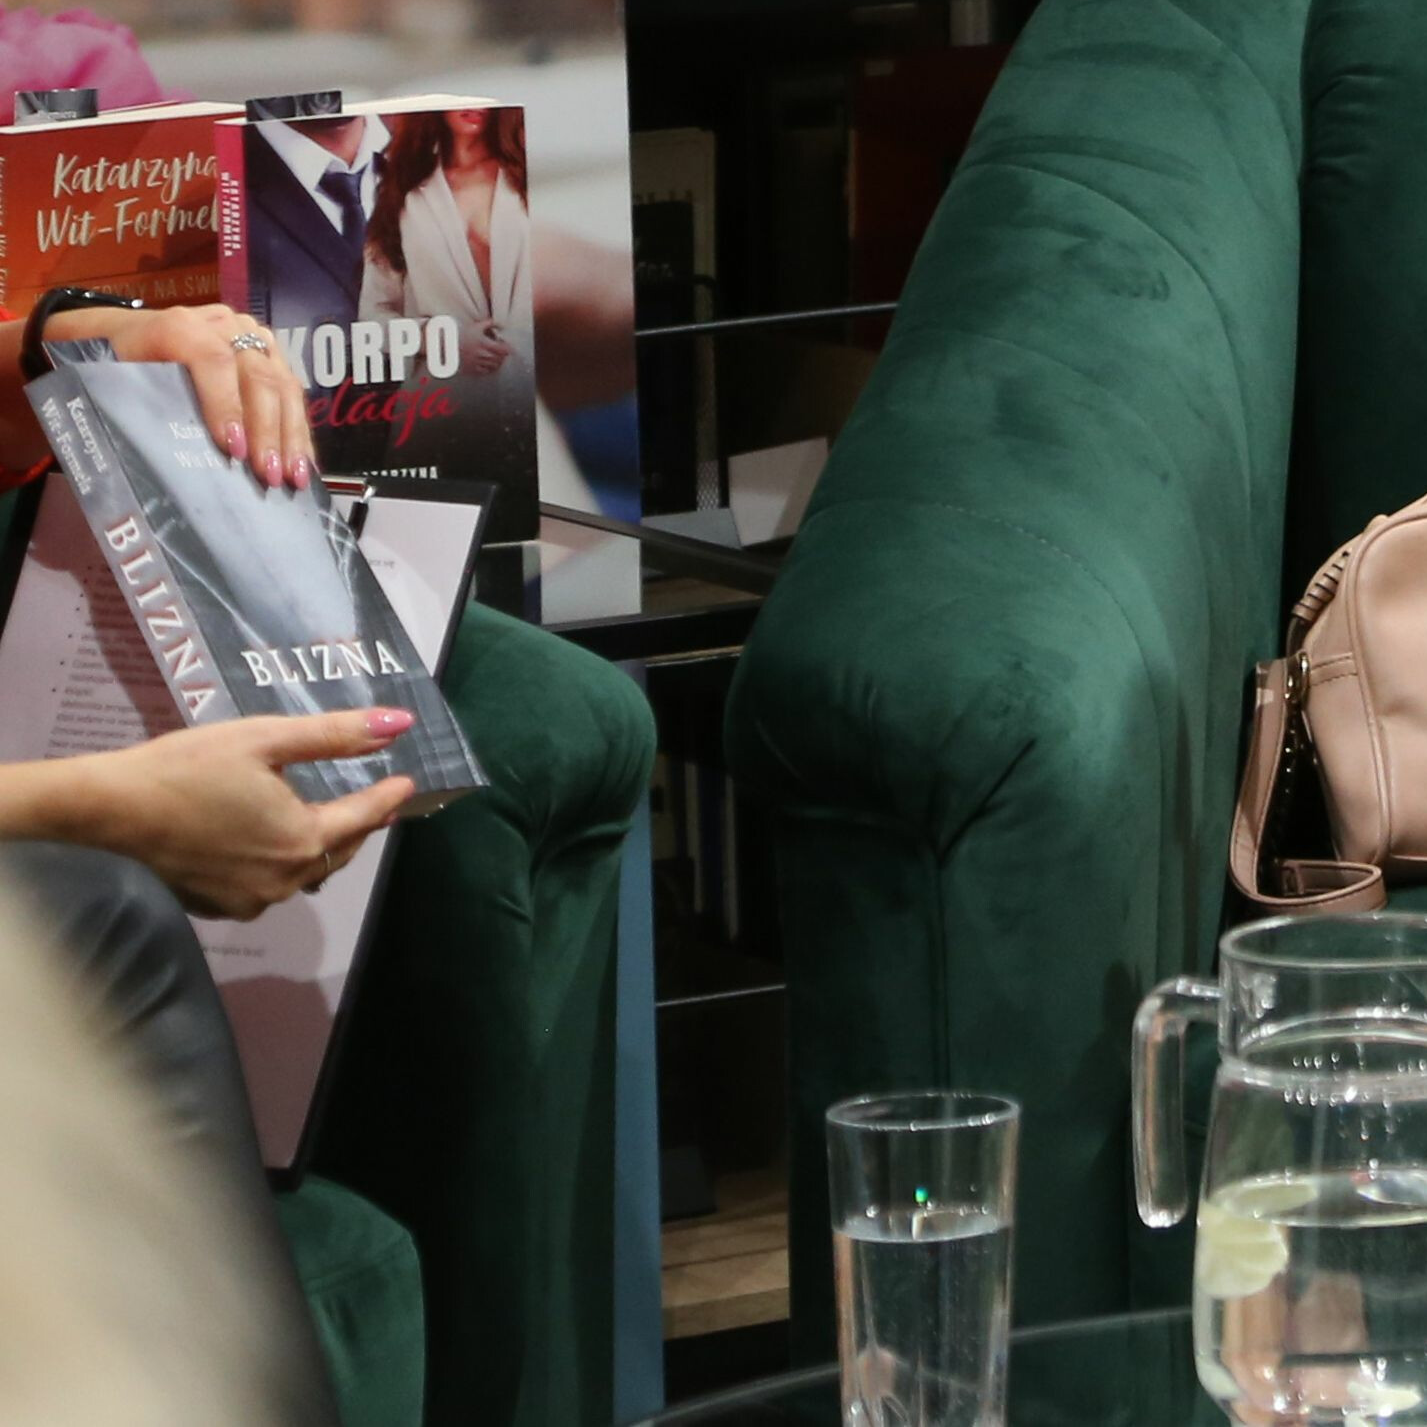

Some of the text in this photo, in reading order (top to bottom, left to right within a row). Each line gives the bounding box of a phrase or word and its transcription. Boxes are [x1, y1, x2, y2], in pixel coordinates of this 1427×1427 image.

[53, 151, 218, 205] Katarzyna
[220, 172, 234, 258] WIT-FORMELA
[230, 179, 242, 251] KATARZYNA
[154, 278, 177, 298] NA
[276, 314, 460, 389] KORPO
[41, 397, 92, 496] Wit-Formela
[66, 396, 108, 475] Katarzyna
[104, 515, 218, 722] BLIZNA
[240, 640, 405, 688] BLIZNA
